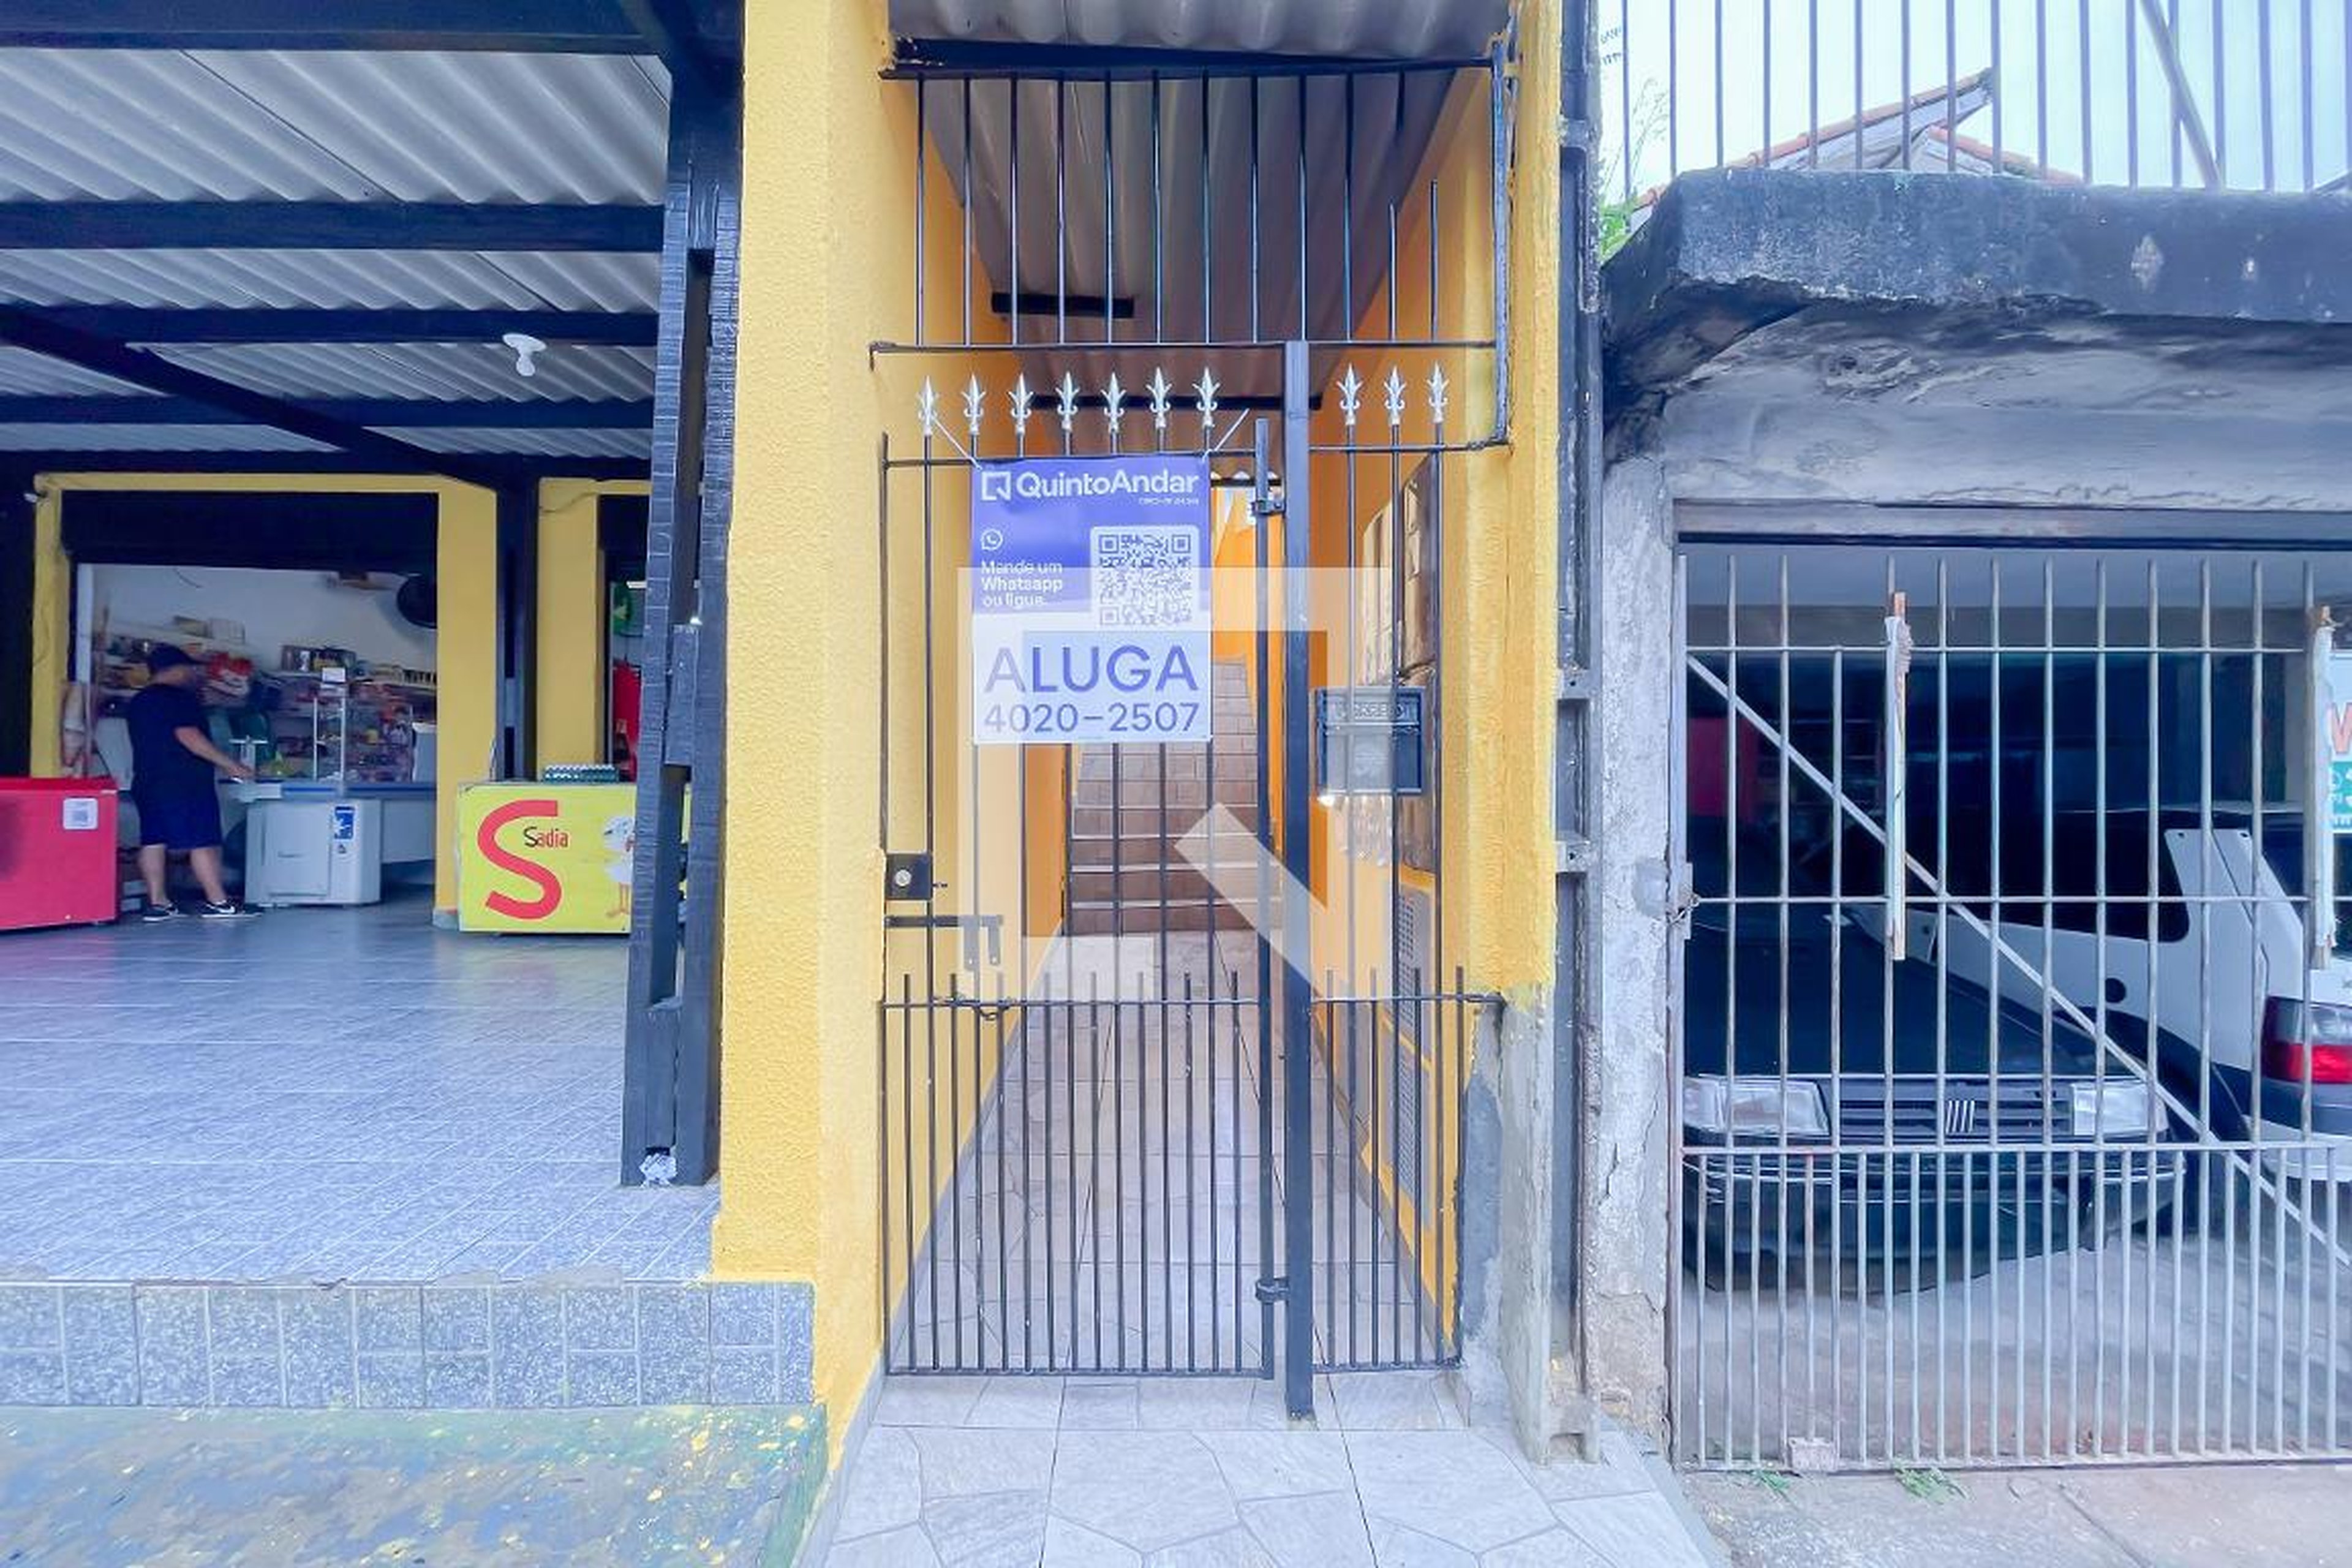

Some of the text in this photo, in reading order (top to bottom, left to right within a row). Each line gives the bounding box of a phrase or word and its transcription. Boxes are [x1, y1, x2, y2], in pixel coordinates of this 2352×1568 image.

[1016, 469, 1199, 498] QuintoAndar
[981, 560, 1063, 574] Mande um
[983, 596, 1003, 607] ou
[984, 645, 1199, 693] ALUGA
[984, 702, 1200, 733] 4020-2507
[524, 826, 568, 848] Sadia
